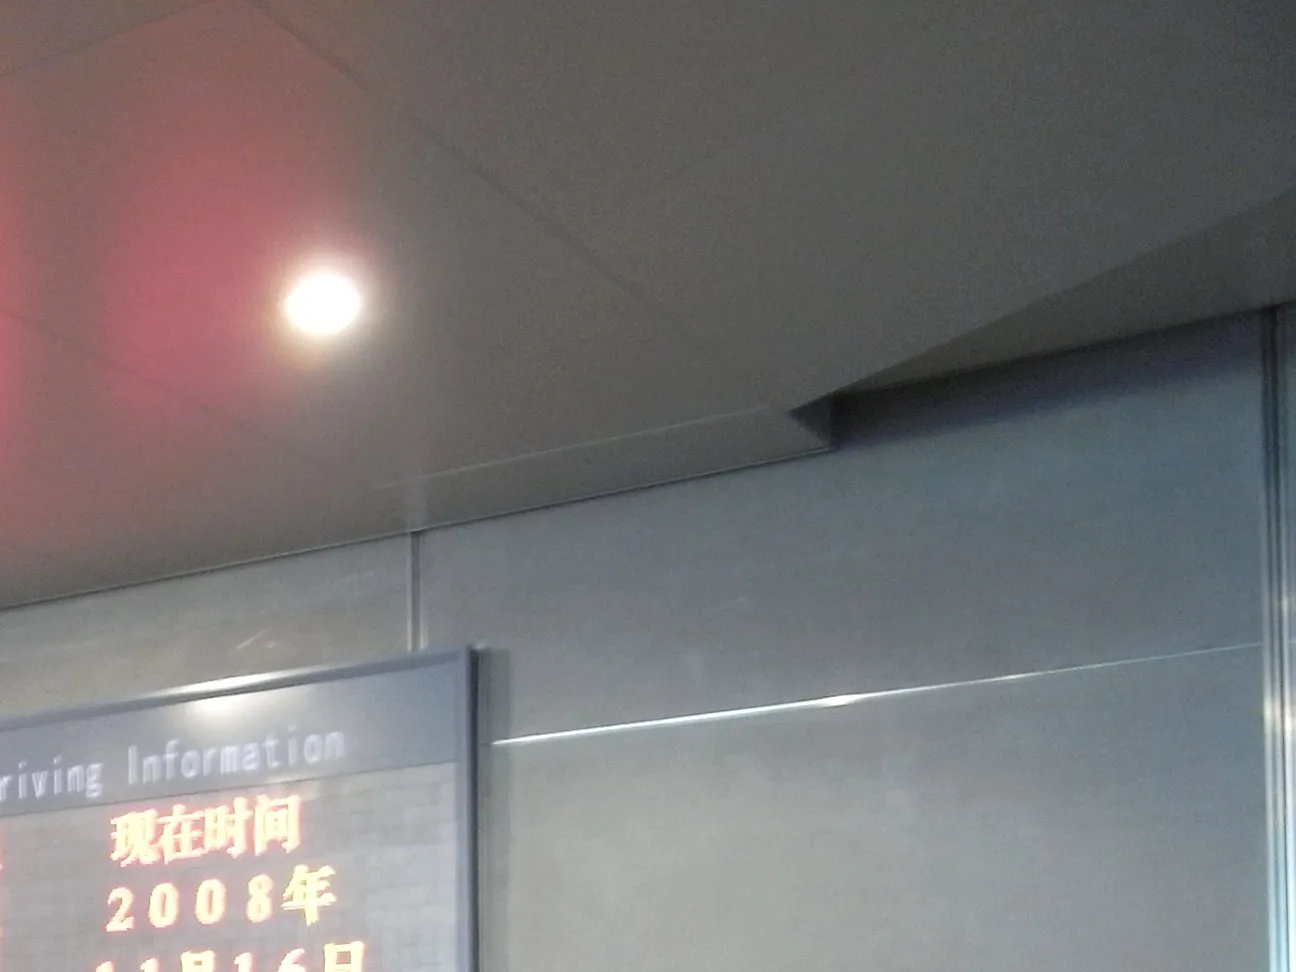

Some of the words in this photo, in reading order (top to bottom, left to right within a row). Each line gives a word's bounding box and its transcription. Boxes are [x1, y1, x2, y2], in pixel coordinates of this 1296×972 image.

[127, 725, 346, 785] Information
[110, 795, 301, 867] 现在时间
[105, 864, 338, 932] 2008年
